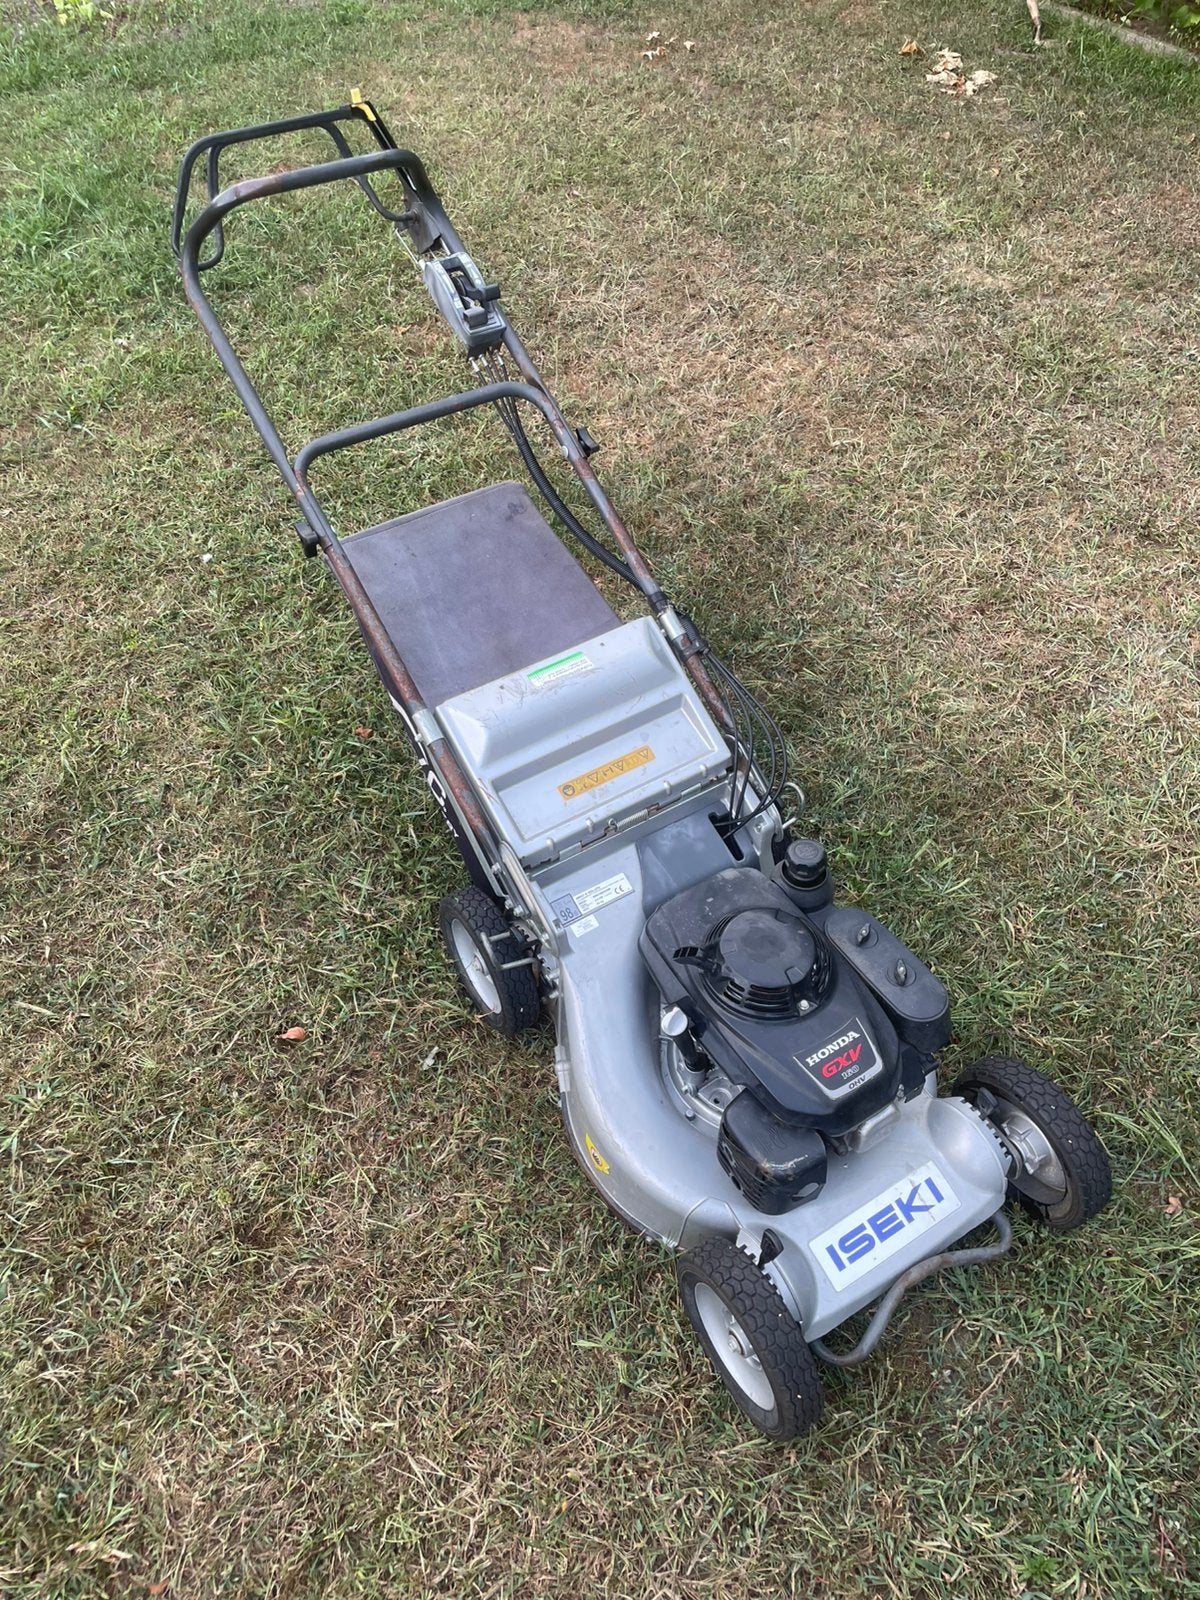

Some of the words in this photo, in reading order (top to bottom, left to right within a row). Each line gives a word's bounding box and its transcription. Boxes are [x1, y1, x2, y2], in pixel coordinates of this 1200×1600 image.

[805, 1031, 861, 1067] HONDA
[822, 1043, 862, 1078] GXV
[848, 1075, 866, 1090] OHV
[825, 1177, 945, 1272] ISEKI
